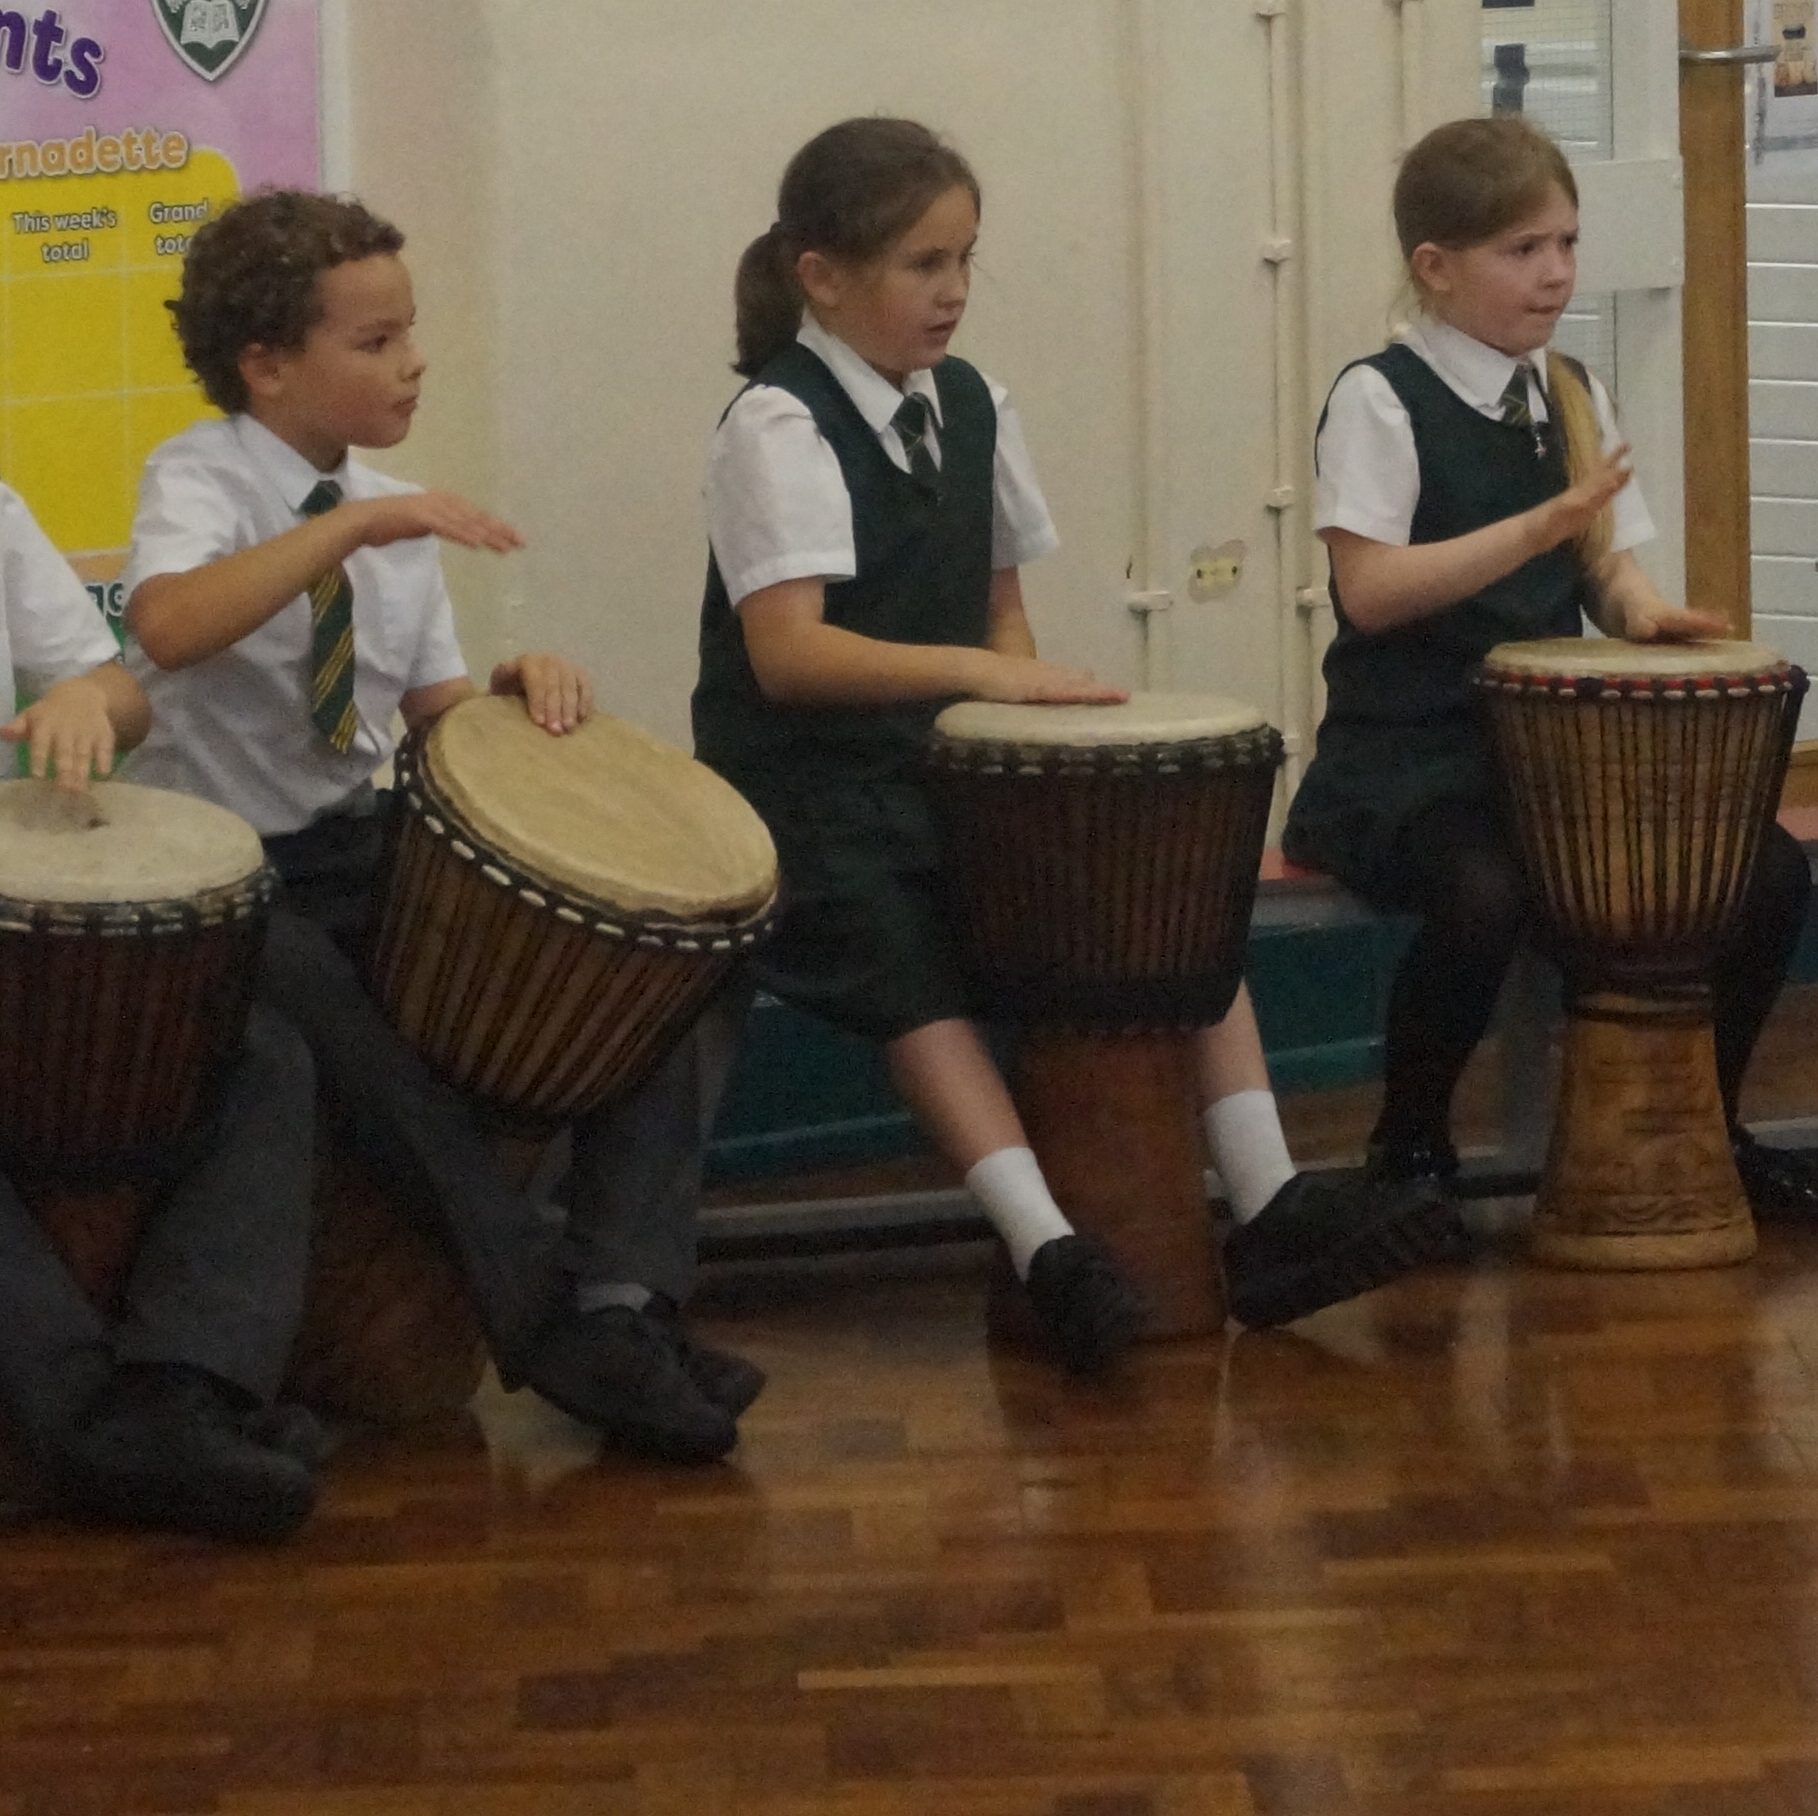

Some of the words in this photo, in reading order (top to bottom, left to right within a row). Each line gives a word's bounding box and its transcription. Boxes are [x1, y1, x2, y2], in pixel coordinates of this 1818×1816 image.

[13, 213, 51, 233] This
[54, 207, 117, 230] week's
[150, 199, 209, 223] Grand
[41, 240, 89, 263] total
